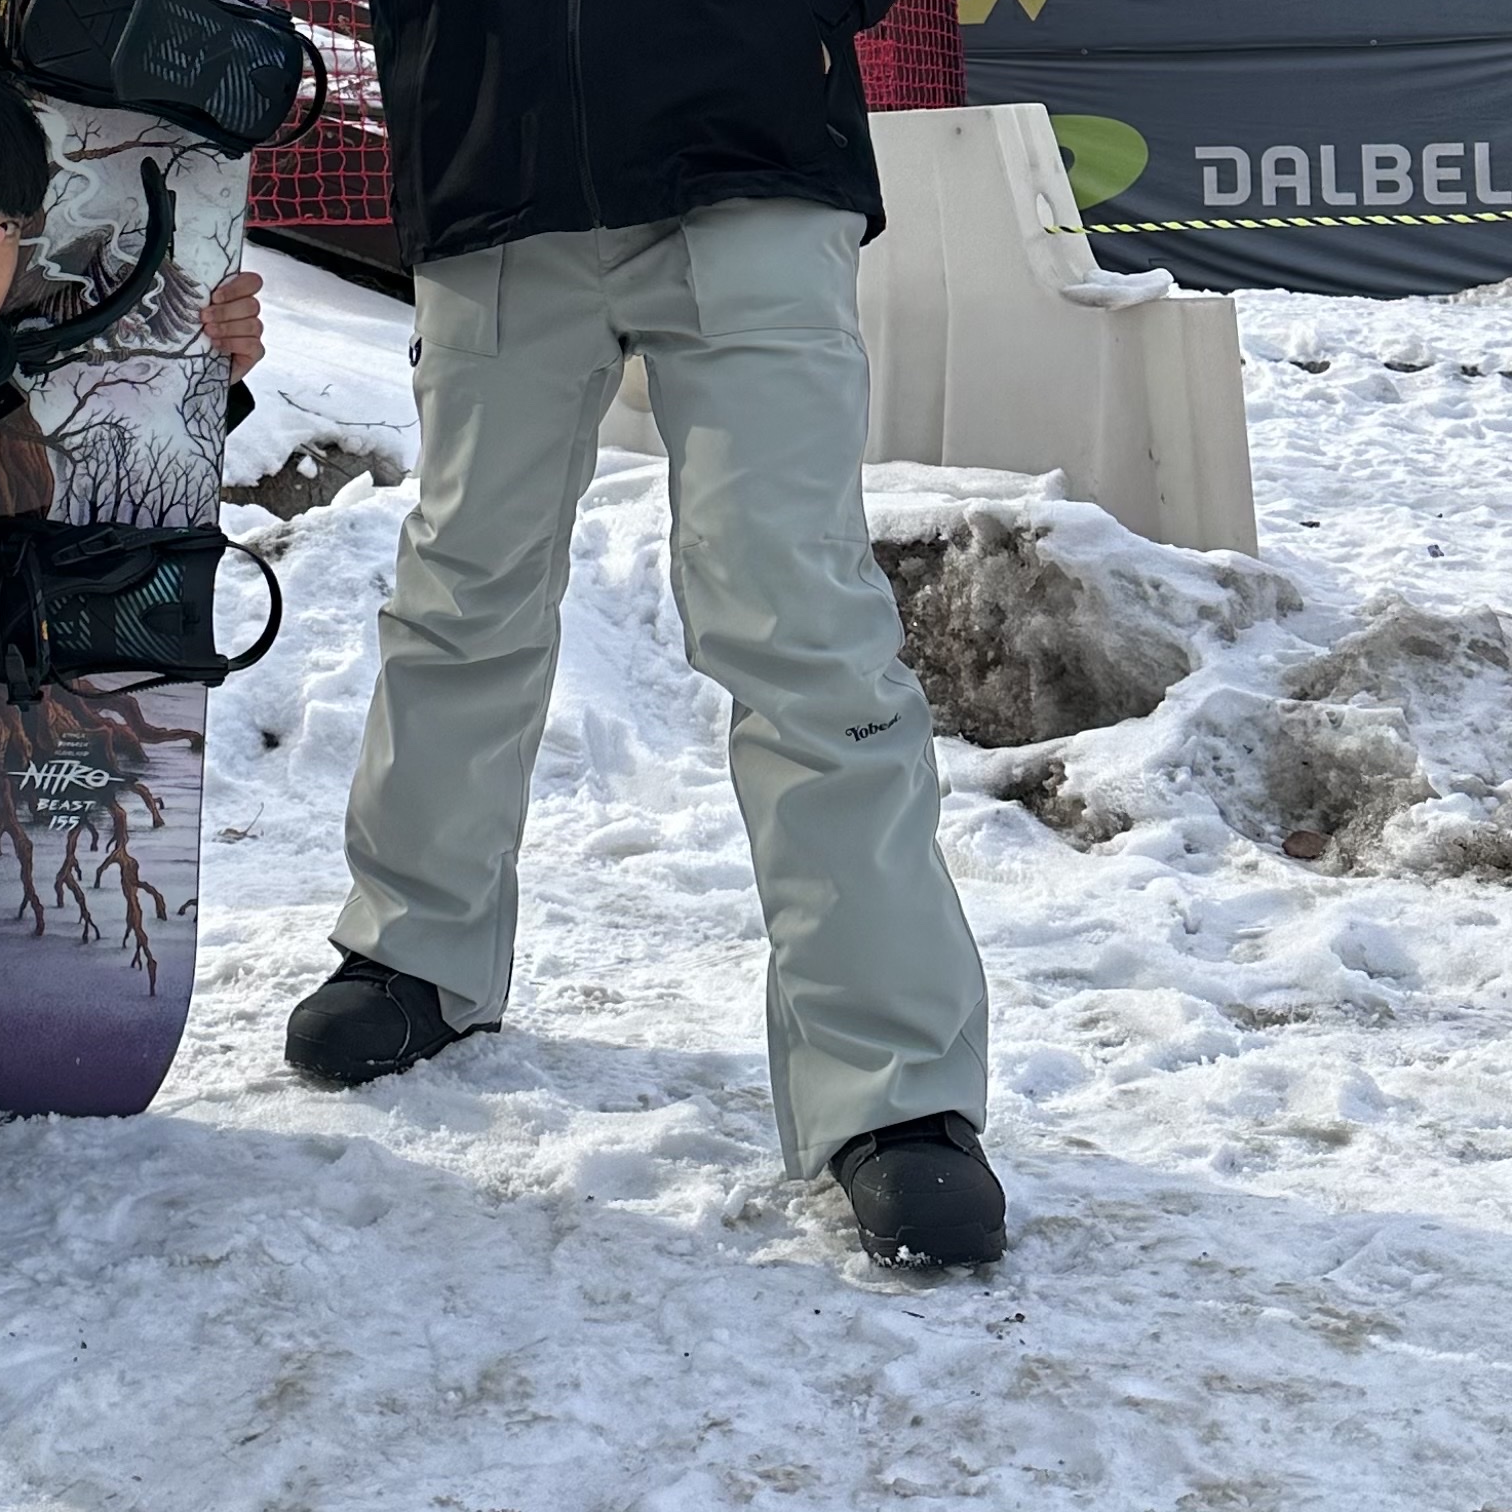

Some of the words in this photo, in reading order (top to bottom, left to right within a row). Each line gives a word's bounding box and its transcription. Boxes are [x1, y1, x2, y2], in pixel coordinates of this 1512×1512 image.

[7, 759, 126, 795] NITRO
[37, 797, 97, 813] BEAST
[48, 814, 81, 832] 155
